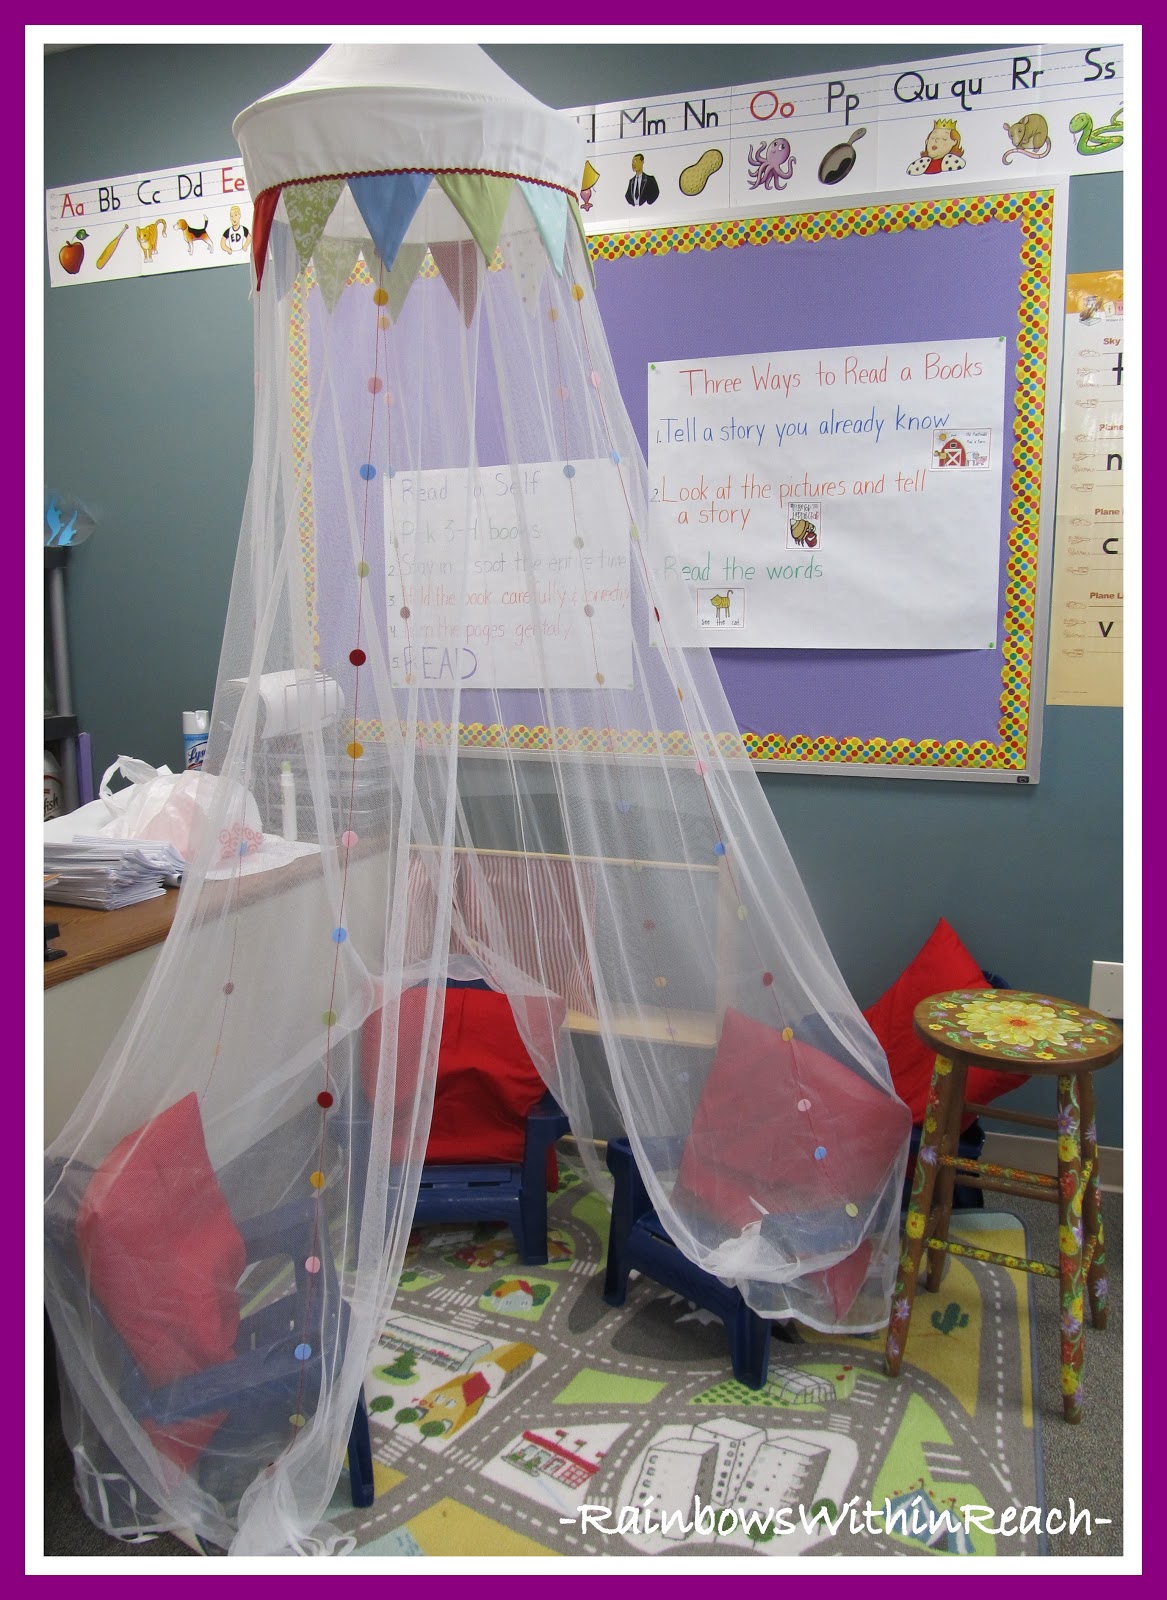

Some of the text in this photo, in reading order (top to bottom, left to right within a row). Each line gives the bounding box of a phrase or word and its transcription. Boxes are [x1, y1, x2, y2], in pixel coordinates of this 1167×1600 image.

[620, 106, 666, 139] Mm
[684, 99, 719, 131] Nn
[750, 90, 795, 121] Oo
[827, 81, 860, 126] Pp
[894, 72, 939, 103] Qu
[950, 77, 983, 112] qu
[1011, 57, 1044, 91] Rr
[1084, 47, 1116, 82] Ss
[60, 166, 245, 219] Aa Bb Cc Dd Ee
[230, 231, 242, 243] ED
[1103, 337, 1121, 346] Sky
[679, 352, 983, 398] Three Ways to Read a Books
[660, 417, 696, 444] Tell
[703, 428, 714, 442] a
[720, 417, 766, 447] story
[776, 423, 808, 448] you
[820, 405, 885, 444] already
[895, 404, 950, 431] know
[1107, 453, 1123, 470] n
[402, 476, 448, 504] Read
[495, 469, 542, 497] Self
[650, 469, 927, 509] 2. Look at the pictures and tell
[677, 500, 751, 531] a story
[1095, 508, 1120, 516] Plane
[488, 516, 542, 542] boos
[474, 551, 507, 577] spot
[664, 550, 823, 582] Read the words
[1090, 592, 1115, 600] Plane
[402, 645, 478, 681] READ
